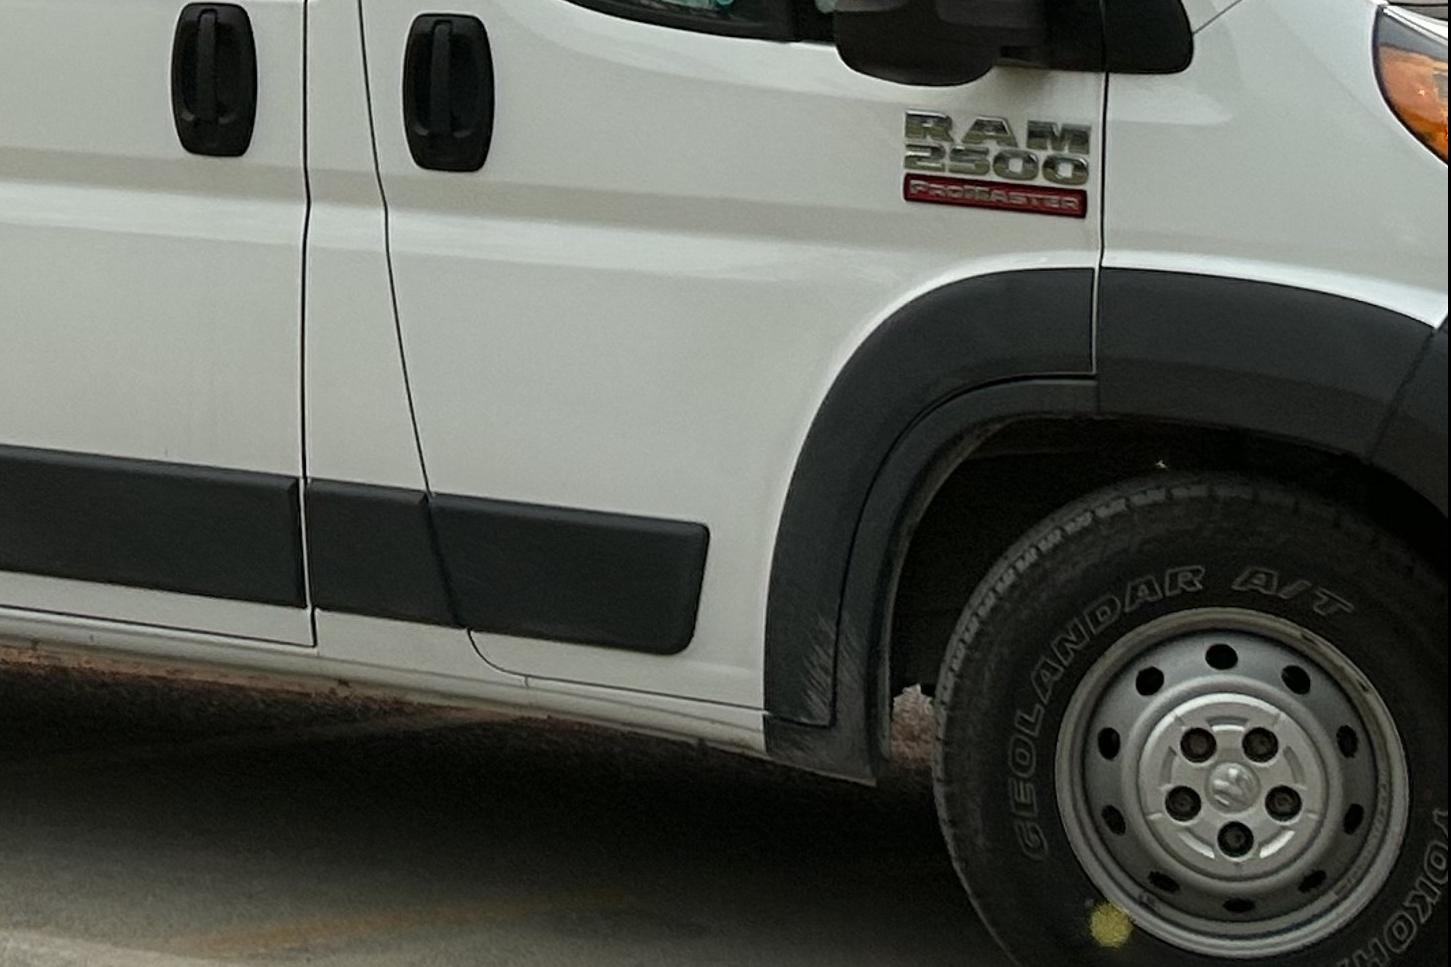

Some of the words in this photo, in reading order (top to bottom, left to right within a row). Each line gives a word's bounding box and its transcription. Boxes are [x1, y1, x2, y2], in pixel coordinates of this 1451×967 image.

[904, 108, 1092, 155] RAM
[903, 142, 1090, 186] 2500
[1007, 565, 1206, 861] GEOLANDAR
[1231, 564, 1355, 617] A/T
